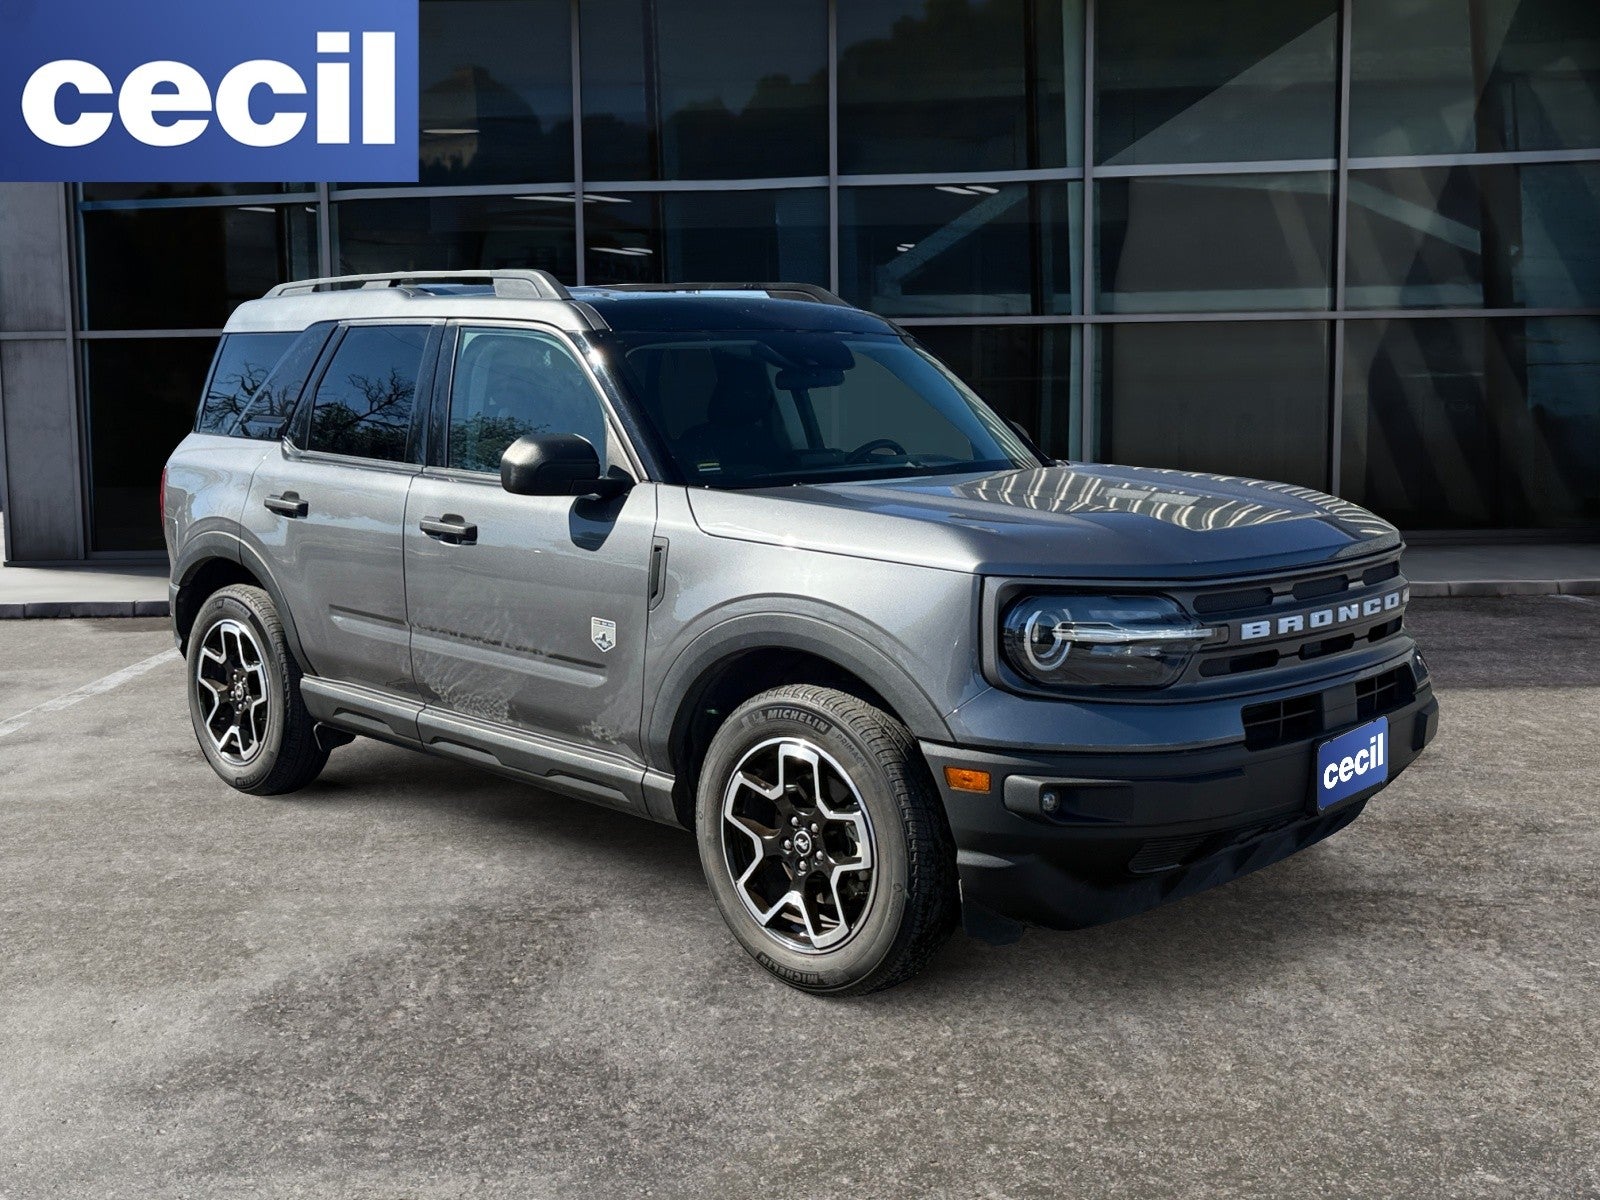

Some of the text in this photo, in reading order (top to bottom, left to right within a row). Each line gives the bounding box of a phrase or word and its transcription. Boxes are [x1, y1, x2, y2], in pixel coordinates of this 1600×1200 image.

[1241, 592, 1400, 640] BRONCO
[767, 709, 867, 768] MICHELIN PRIMACY
[760, 953, 819, 985] MICHELIN
